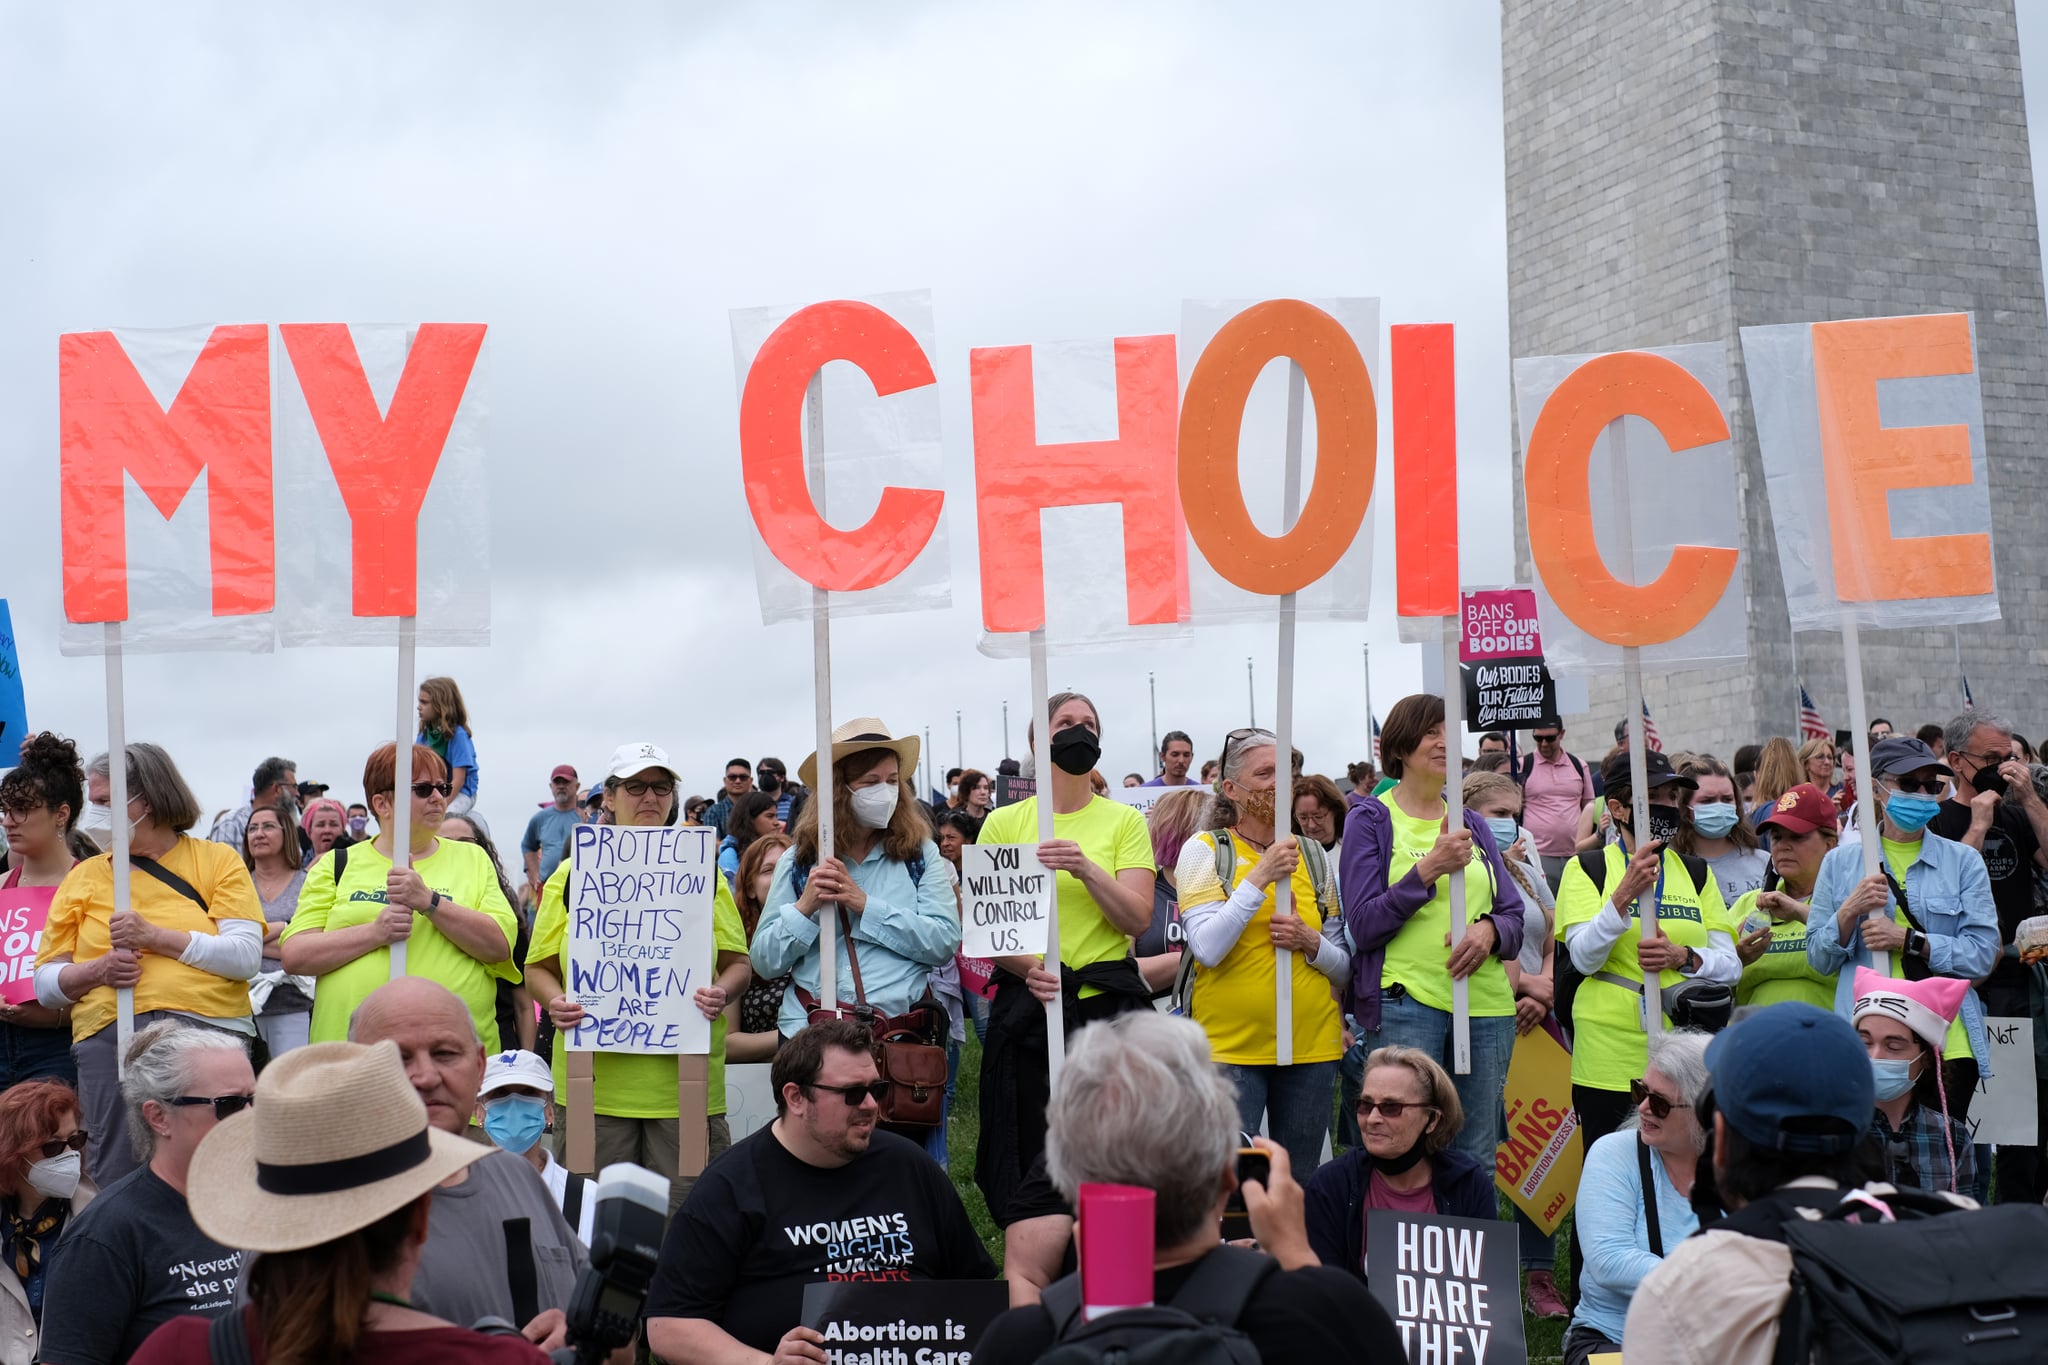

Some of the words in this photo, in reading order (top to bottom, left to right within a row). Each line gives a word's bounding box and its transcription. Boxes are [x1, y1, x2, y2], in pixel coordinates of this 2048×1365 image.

[59, 323, 488, 623] MY
[740, 298, 1997, 648] CHOICE
[1467, 603, 1515, 620] BANS
[1467, 620, 1502, 636] OFF
[1504, 619, 1540, 635] OUR
[1469, 635, 1535, 653] BODIES
[1500, 665, 1541, 684] BODIES
[1479, 690, 1502, 706] OUR
[1503, 684, 1545, 708] Futures
[1498, 707, 1542, 721] ABORTIONS
[1008, 779, 1028, 790] HANDS
[1008, 790, 1017, 799] MY
[1650, 816, 1670, 828] ANS
[575, 826, 712, 870] PROTECT
[984, 847, 1019, 871] YOU
[578, 871, 706, 905] ABORTION
[967, 876, 1008, 896] WILL
[1009, 874, 1045, 895] NOT
[1662, 894, 1696, 904] RESTON
[973, 900, 1045, 926] CONTROL
[575, 908, 683, 943] RIGHTS
[600, 941, 674, 960] BECAUSE
[990, 928, 1024, 951] US.
[572, 958, 691, 999] WOMEN
[617, 996, 658, 1016] ARE
[573, 1012, 680, 1048] PEOPLE
[1986, 1023, 2020, 1045] Not
[1495, 1097, 1569, 1187] BANS.
[1523, 1152, 1554, 1196] ABORTION
[1549, 1125, 1573, 1156] ACCESS
[1543, 1192, 1567, 1223] ACLU
[784, 1212, 909, 1246] WOMEN'S
[827, 1231, 914, 1259] RIGHTS
[1397, 1221, 1486, 1281] HOW
[185, 1280, 220, 1297] she
[1395, 1273, 1493, 1328] DARE
[824, 1319, 939, 1341] Abortion
[945, 1318, 966, 1340] is
[825, 1347, 909, 1365] Health
[914, 1347, 972, 1365] Care
